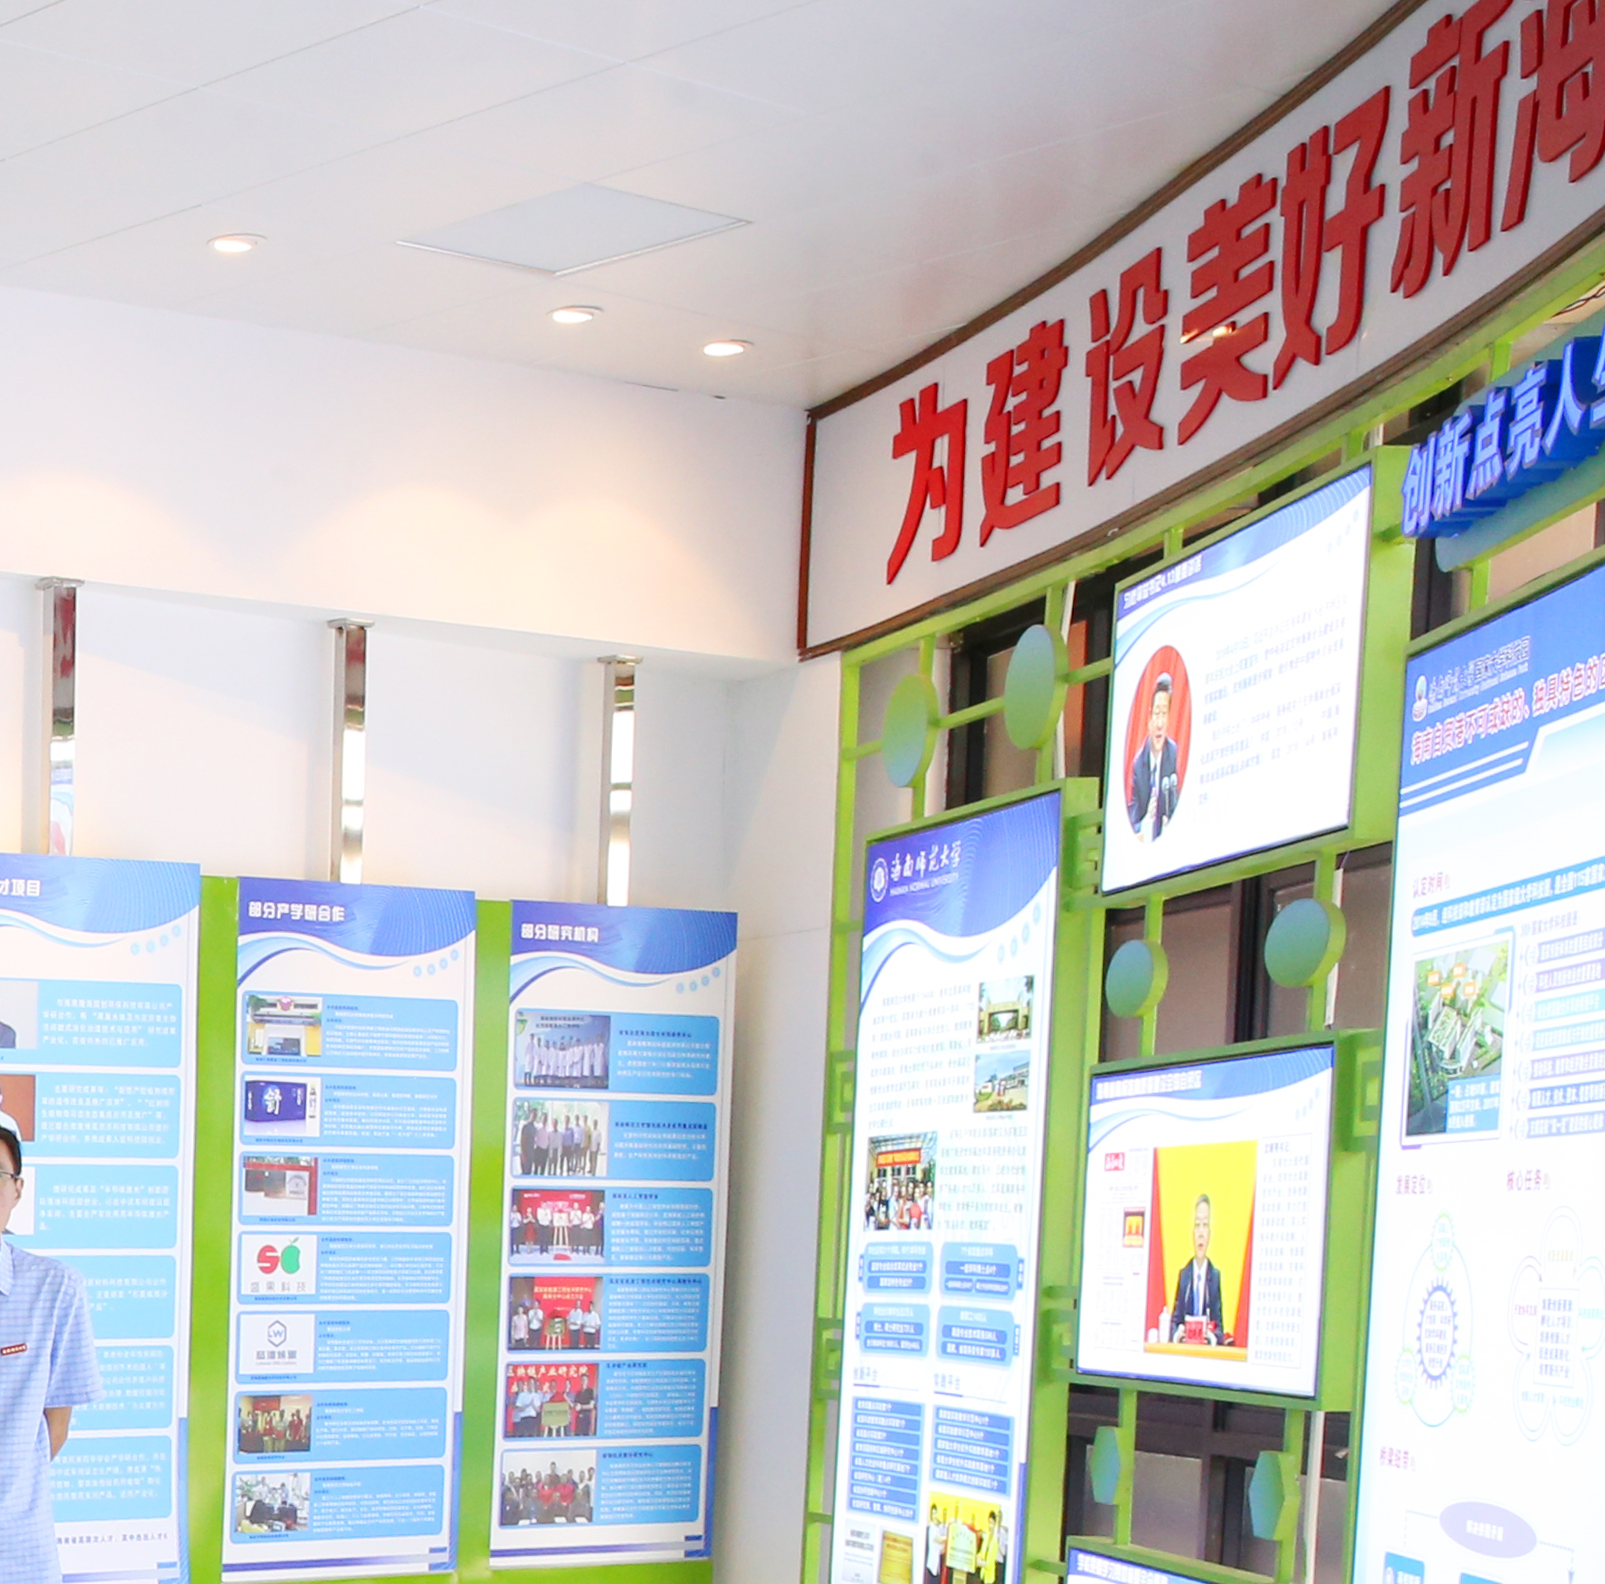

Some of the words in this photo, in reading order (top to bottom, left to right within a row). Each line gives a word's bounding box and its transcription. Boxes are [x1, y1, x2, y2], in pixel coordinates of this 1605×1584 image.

[1401, 331, 1605, 538] 创新点亮人
[248, 901, 346, 922] 部分产学研合作
[520, 923, 600, 942] 部分研究机构
[250, 1281, 307, 1293] 盛果科技
